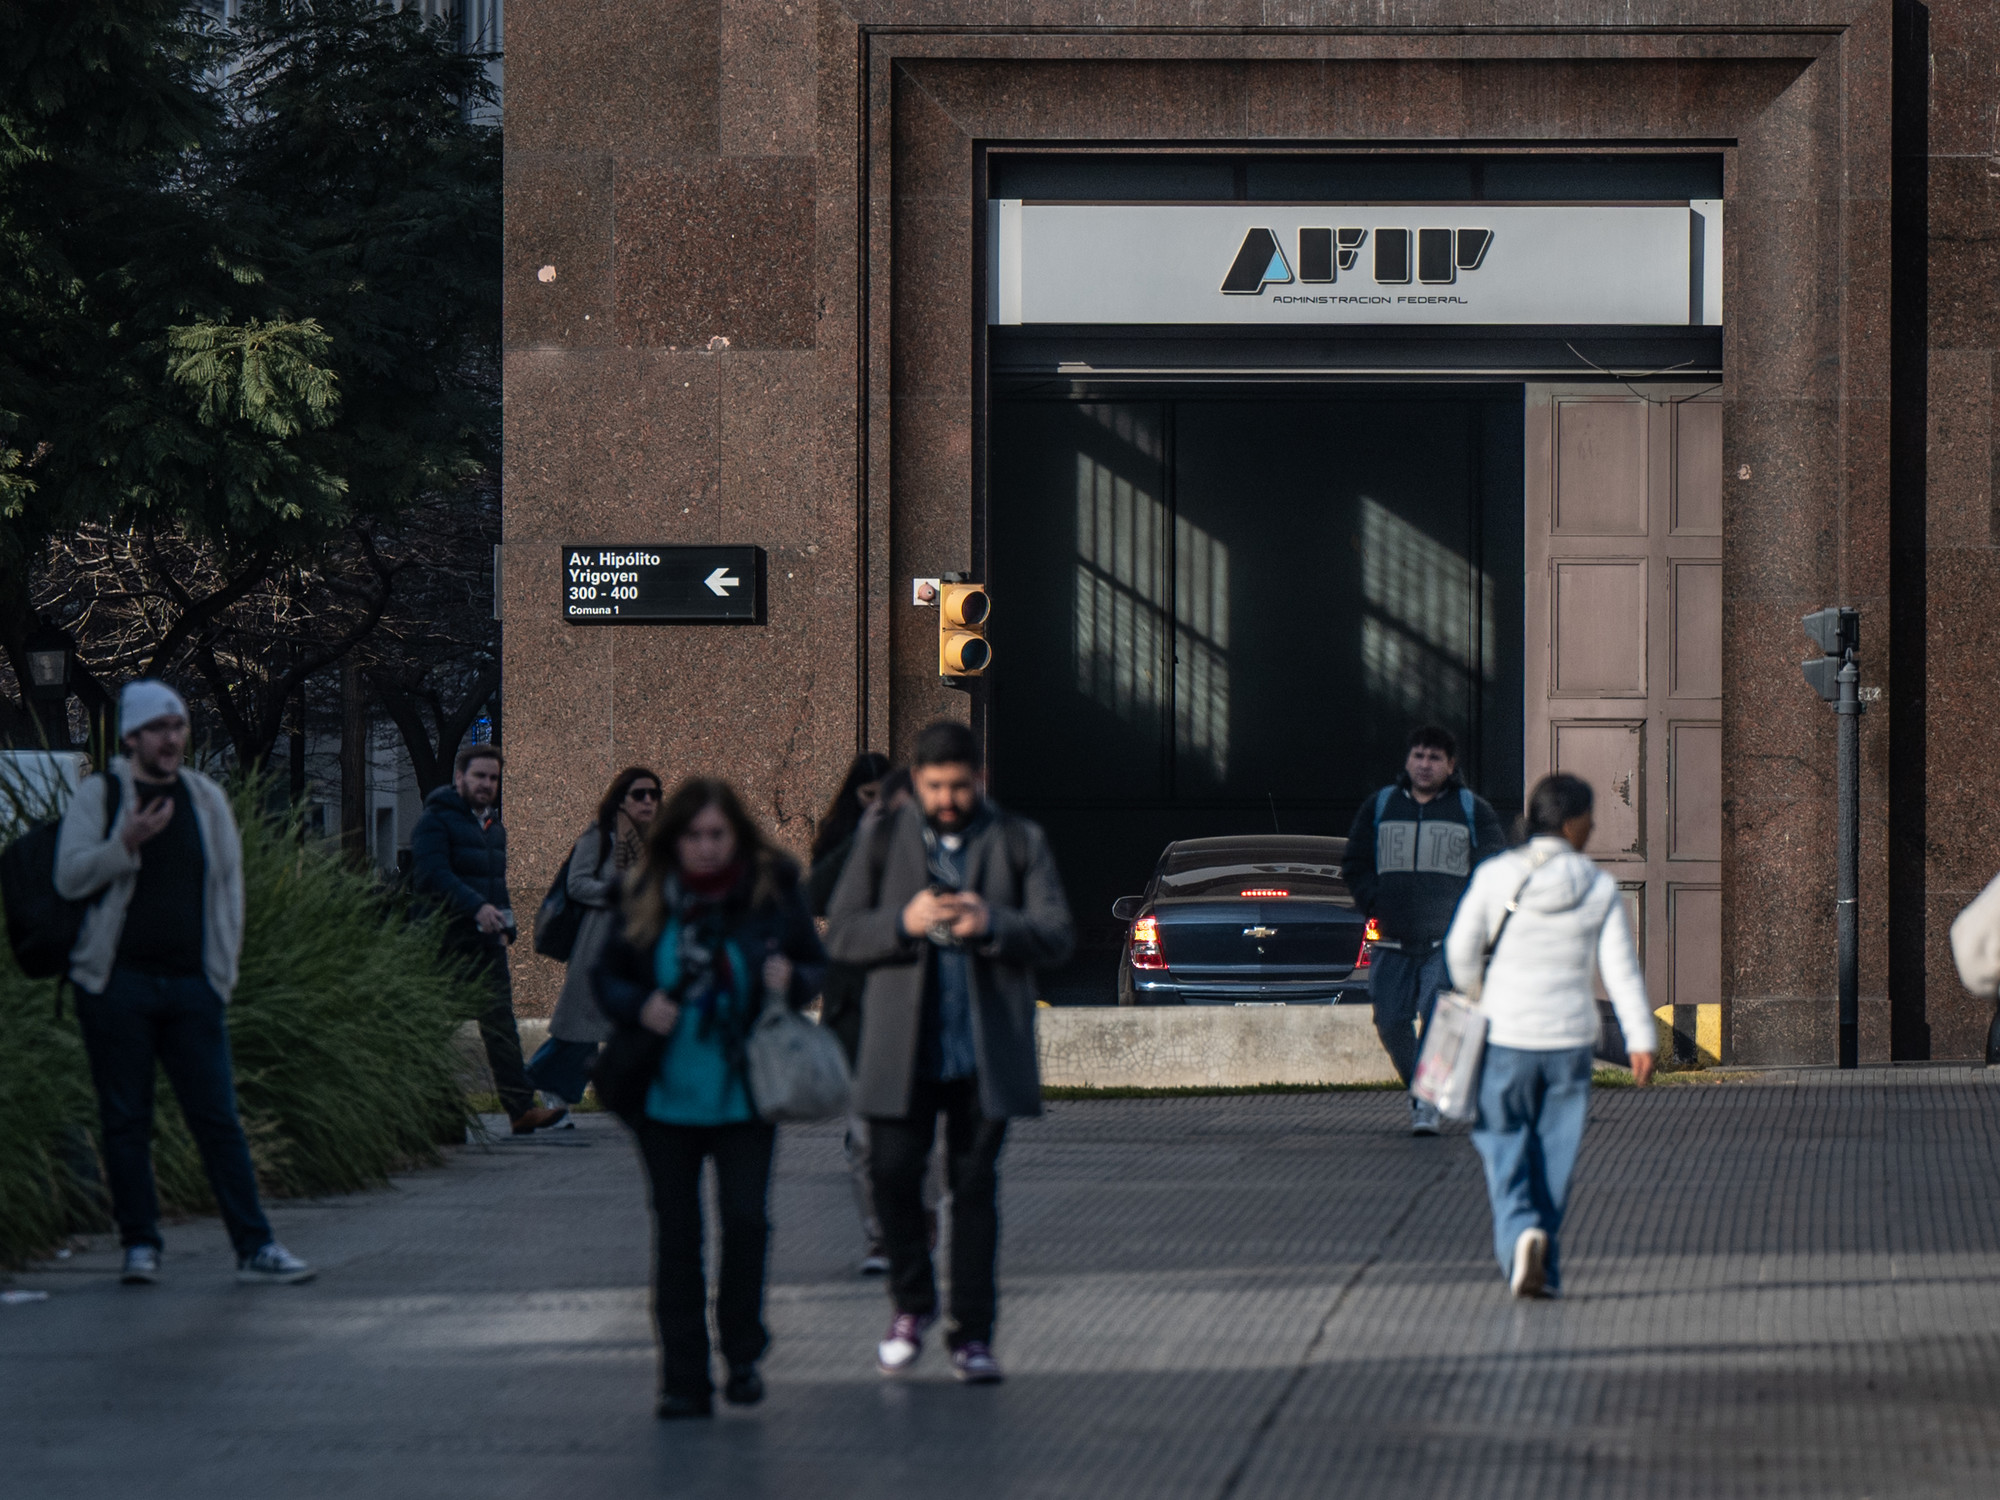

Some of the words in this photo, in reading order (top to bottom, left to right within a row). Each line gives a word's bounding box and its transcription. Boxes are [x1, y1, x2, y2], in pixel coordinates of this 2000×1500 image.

[1219, 226, 1494, 295] AFIP
[1273, 295, 1391, 304] ADMINISTRACION
[1397, 296, 1468, 304] FEDERAL
[569, 552, 594, 566] Av.
[599, 552, 660, 568] Hipólito
[569, 569, 638, 585] Yrigoyen
[569, 586, 597, 600] 300
[610, 586, 638, 600] 400
[569, 605, 611, 615] Comuna
[614, 605, 619, 615] 1
